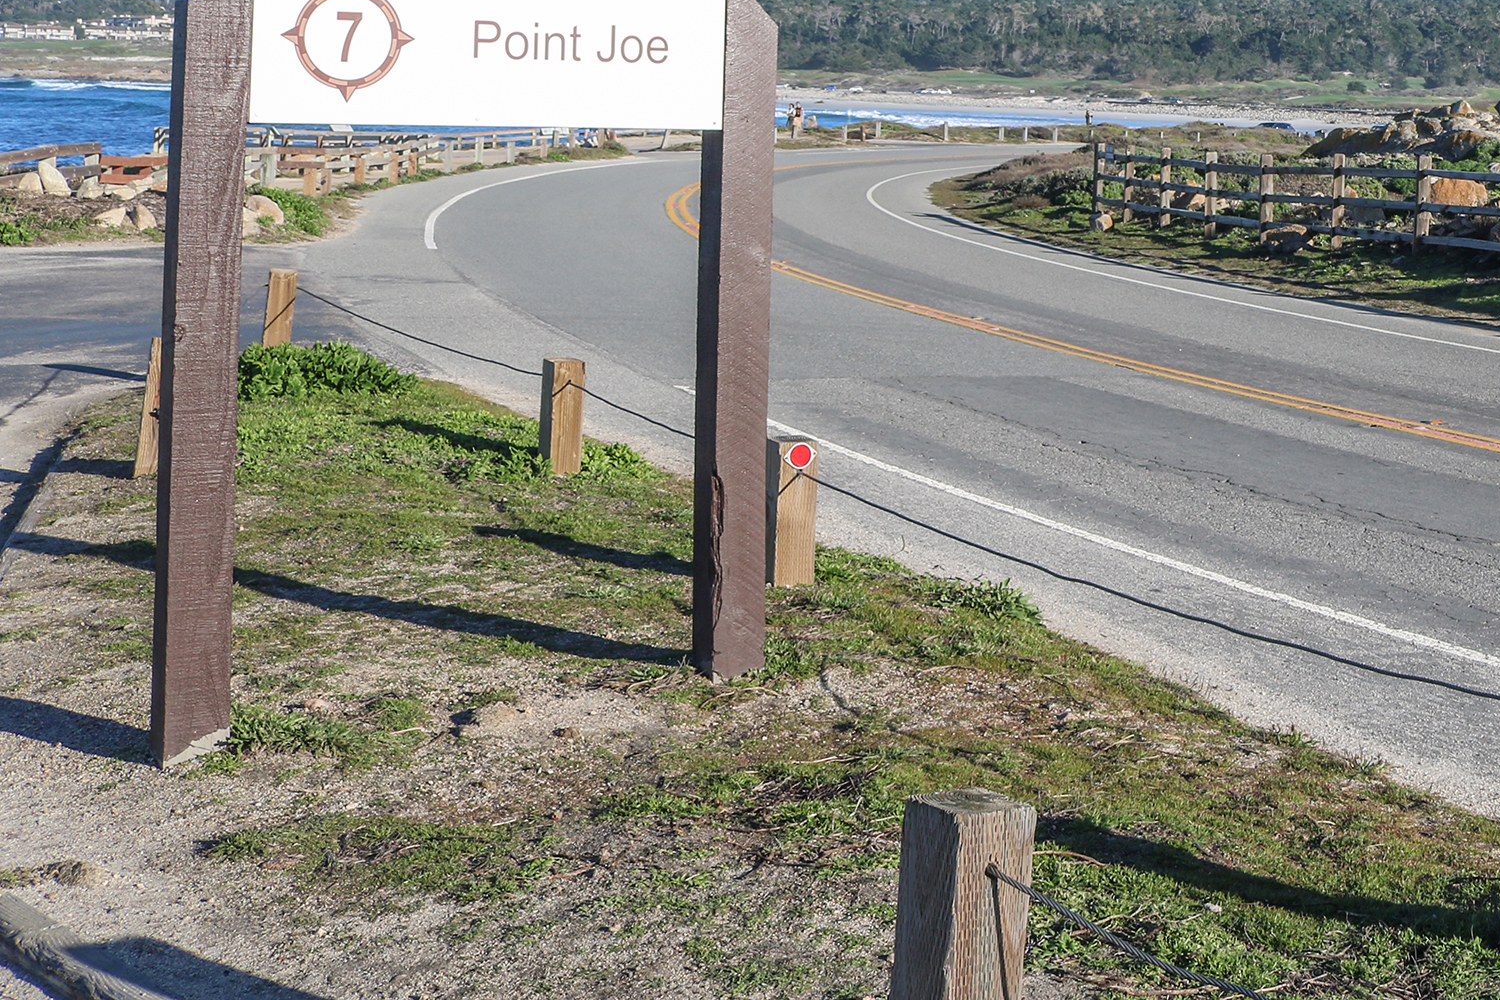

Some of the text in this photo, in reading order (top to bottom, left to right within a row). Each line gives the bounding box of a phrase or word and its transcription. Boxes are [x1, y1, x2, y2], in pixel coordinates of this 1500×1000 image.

[336, 11, 363, 63] 7
[473, 20, 669, 64] Point Joe
